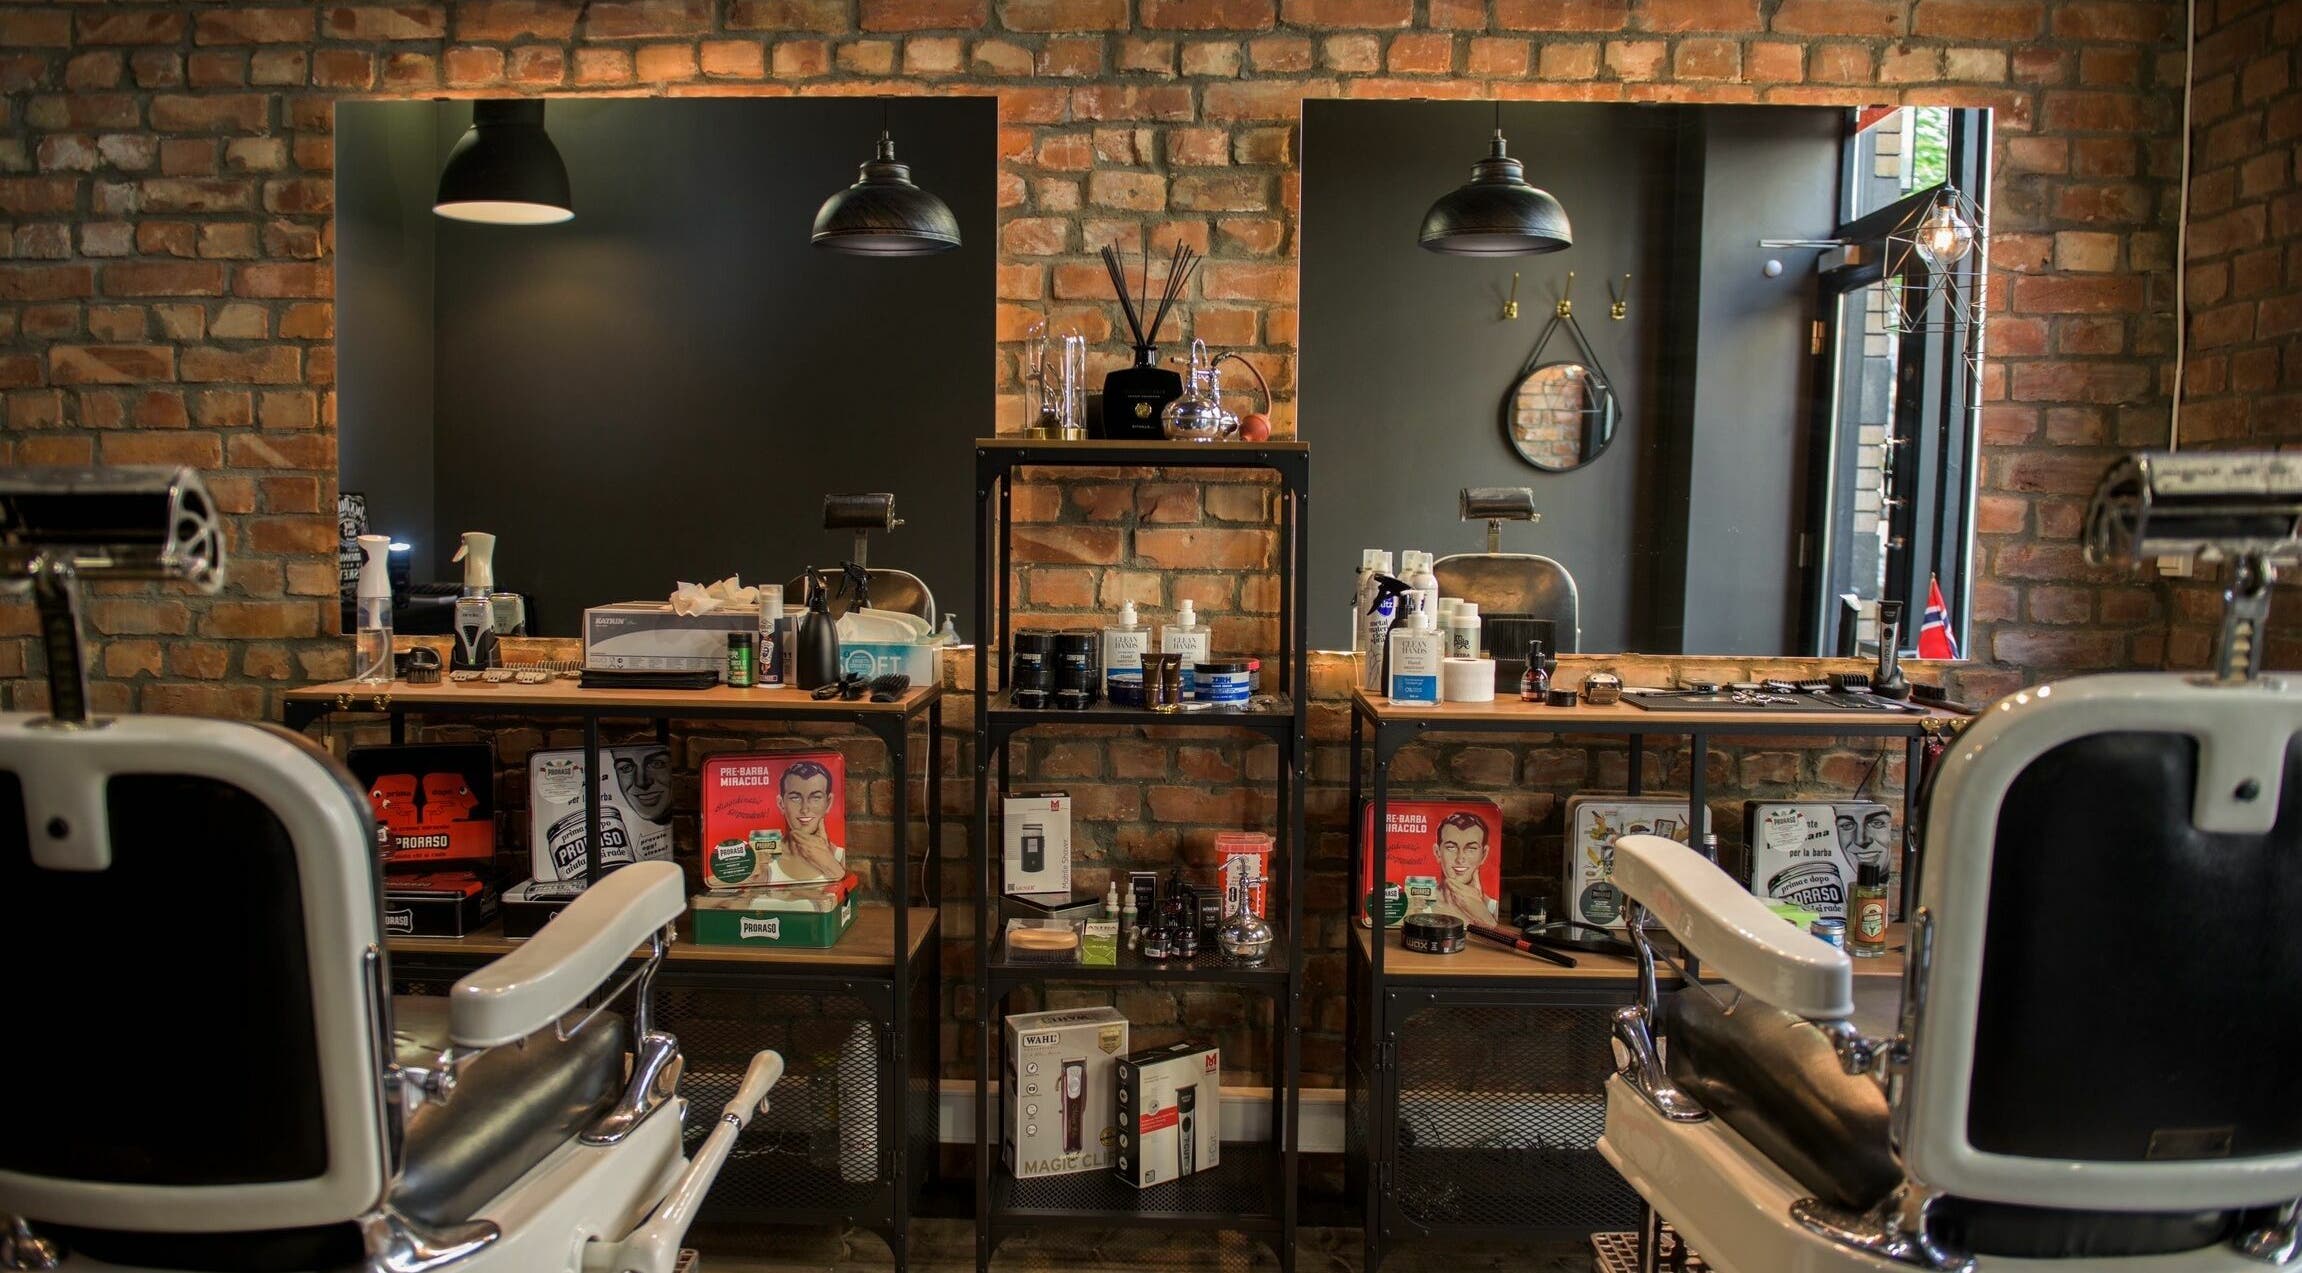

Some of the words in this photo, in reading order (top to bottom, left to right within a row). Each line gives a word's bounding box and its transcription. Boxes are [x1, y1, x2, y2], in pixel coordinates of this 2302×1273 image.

[1402, 640, 1427, 648] CLEAN
[720, 767, 769, 777] PRE-BARBA
[720, 776, 770, 787] MIRACOLO
[1386, 814, 1427, 824] RE-BARBA
[1386, 823, 1427, 833] IRACOLO
[561, 826, 584, 843] prima
[396, 835, 448, 850] PRORASO
[558, 832, 623, 860] PROSO
[720, 846, 744, 857] PRORASO
[1790, 849, 1801, 858] per
[1803, 849, 1810, 857] la
[1812, 848, 1832, 857] barba
[1781, 879, 1803, 893] prima
[1809, 875, 1830, 887] dopo
[1797, 887, 1839, 905] ORASO
[1823, 904, 1842, 912] rade
[385, 916, 408, 926] ORASO
[743, 922, 777, 934] PRORASO
[1406, 938, 1428, 950] wax
[1026, 1034, 1057, 1044] WAHL
[1024, 1157, 1077, 1175] MAGIC
